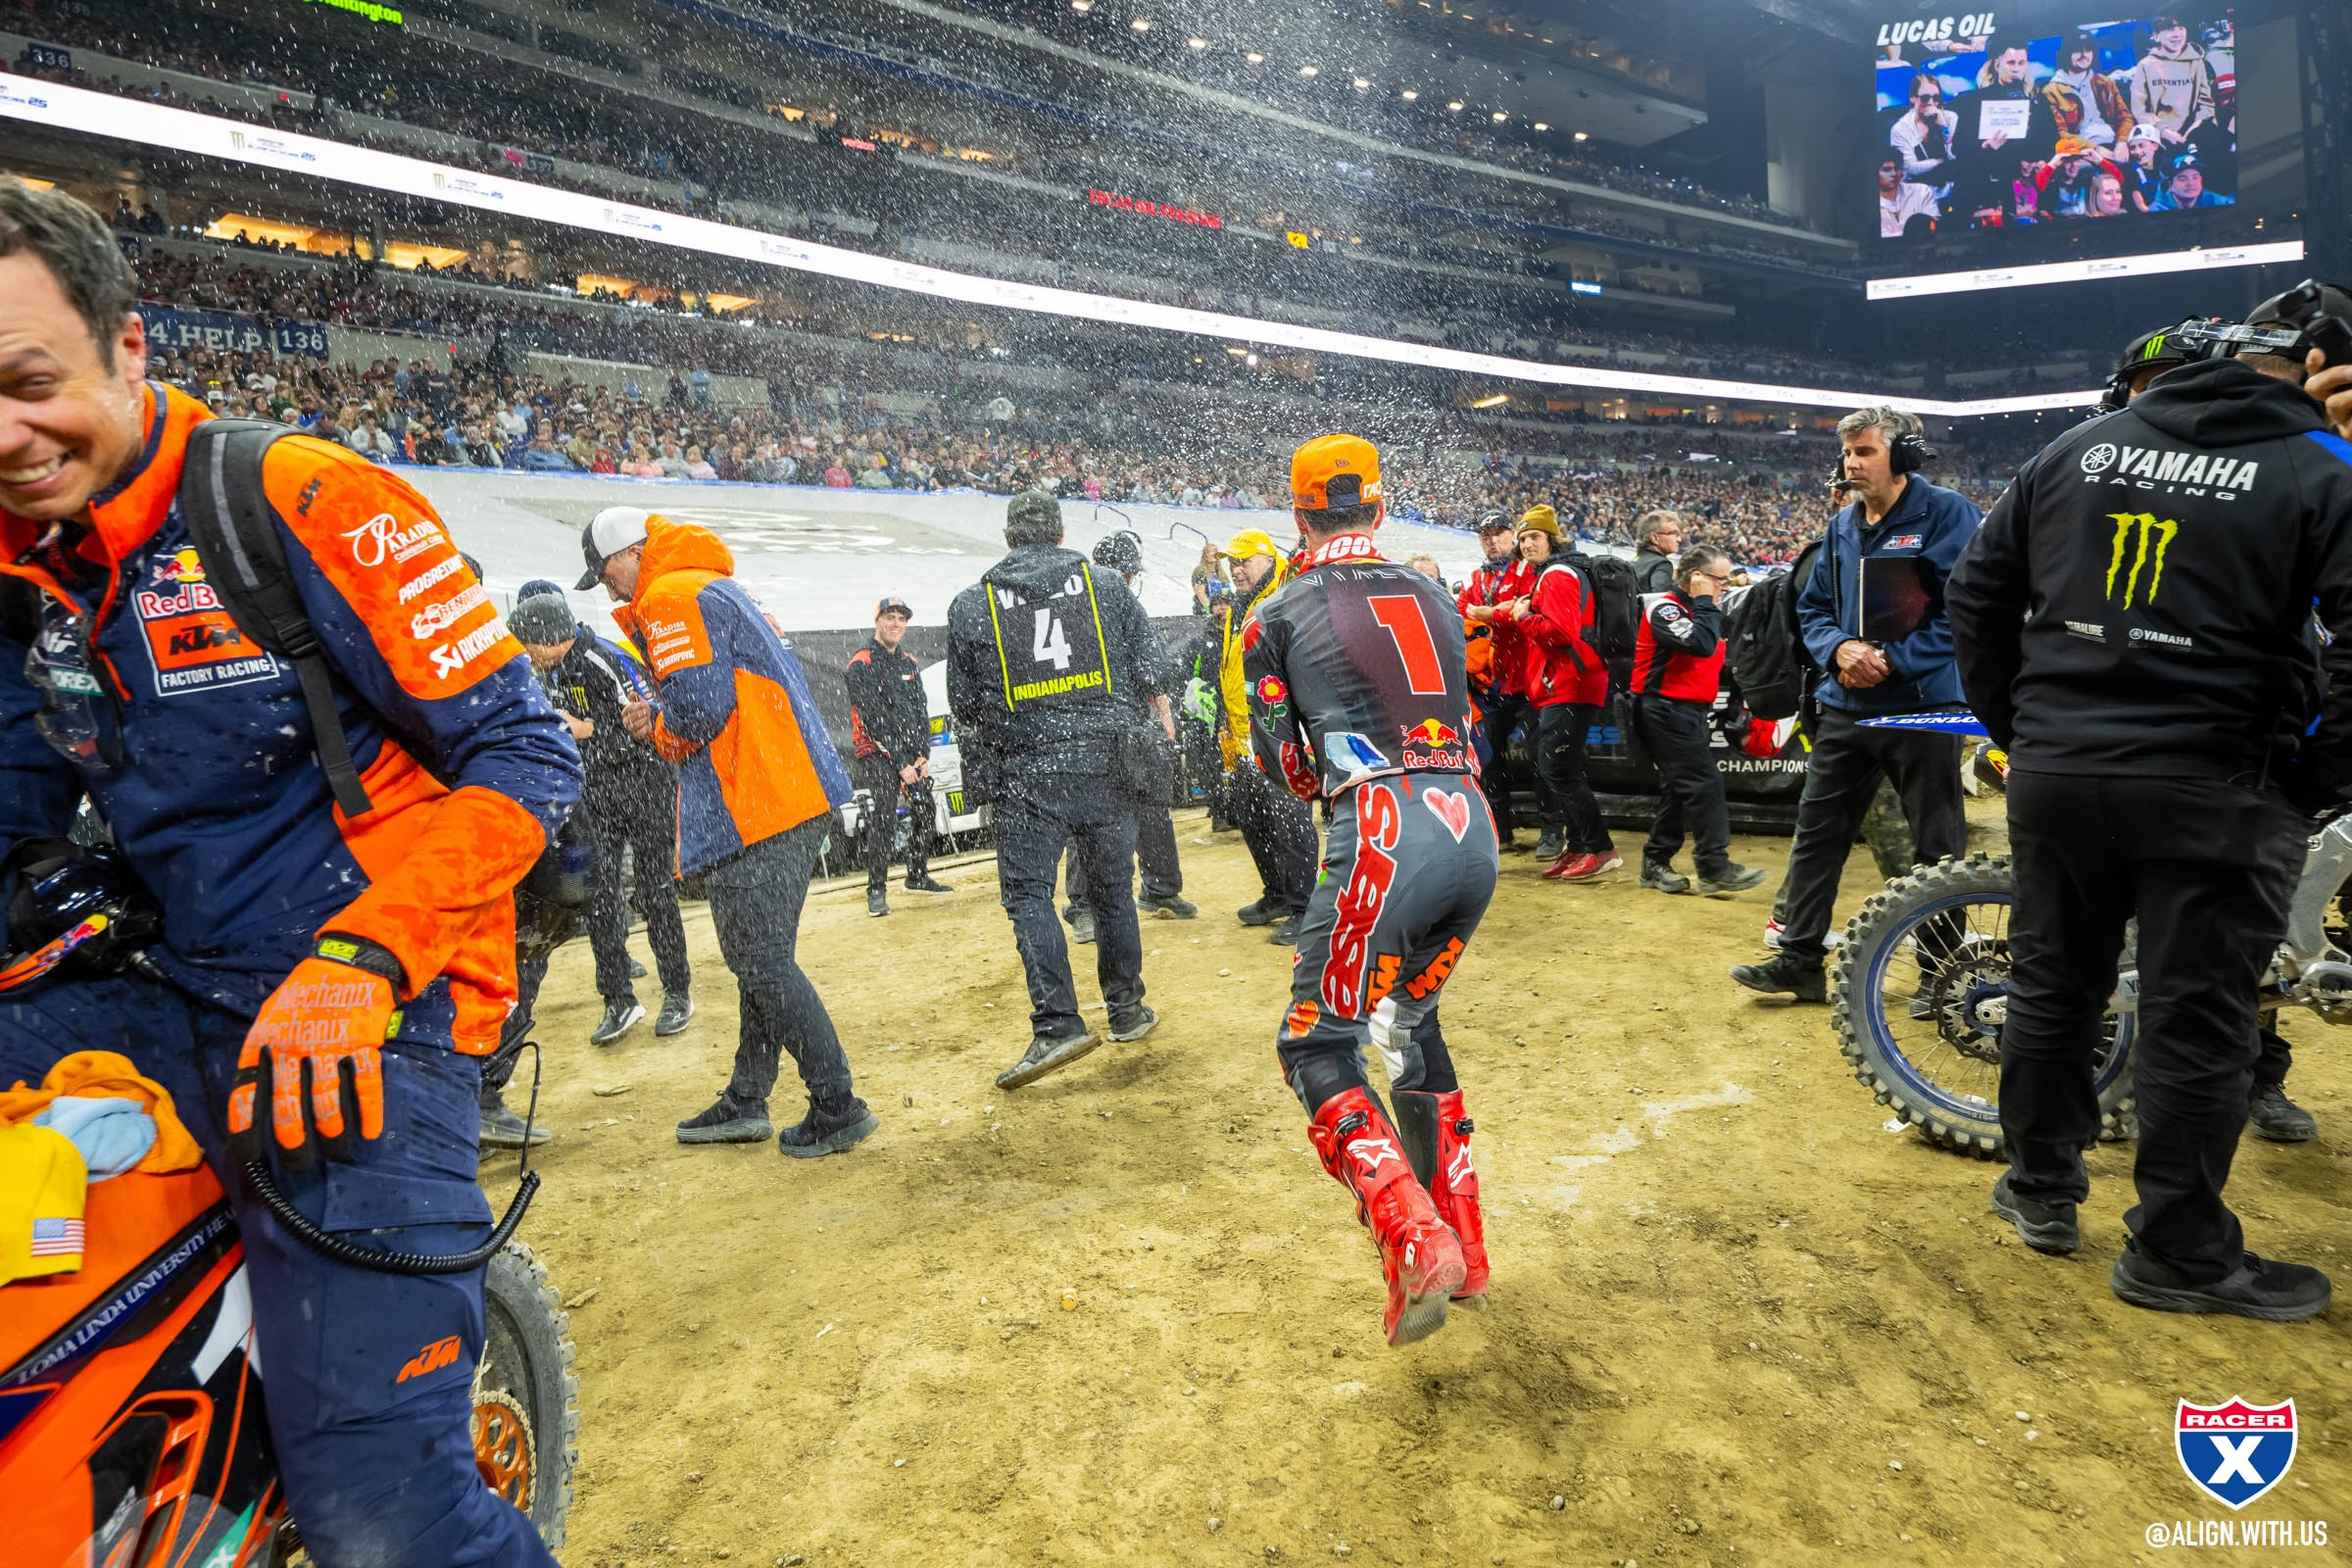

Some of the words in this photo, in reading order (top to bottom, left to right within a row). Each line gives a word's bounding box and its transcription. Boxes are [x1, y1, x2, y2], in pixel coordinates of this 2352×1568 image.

[1876, 16, 1955, 46] LUCAS
[1958, 12, 1996, 37] OIL
[31, 48, 70, 69] 336
[280, 328, 324, 351] 136
[2117, 445, 2260, 492] YAMAHA
[296, 477, 323, 518] KTM
[2083, 474, 2237, 502] RACING
[139, 584, 190, 618] Red
[169, 620, 242, 657] KTM
[1033, 608, 1073, 670] 4
[1366, 593, 1446, 697] 1
[2143, 629, 2193, 647] YAMAHA
[161, 668, 217, 689] FACTORY
[216, 658, 270, 680] RACING
[1012, 670, 1104, 702] INDIANAPOLIS
[1402, 749, 1440, 769] Red
[1438, 750, 1465, 769] Bull
[277, 972, 376, 1012] Mechanix
[245, 1010, 351, 1051] Mechanix
[18, 1339, 77, 1385] LOMA
[75, 1298, 128, 1348] LINDA
[124, 1230, 207, 1304] UNIVERSITY
[395, 1334, 463, 1384] KTM
